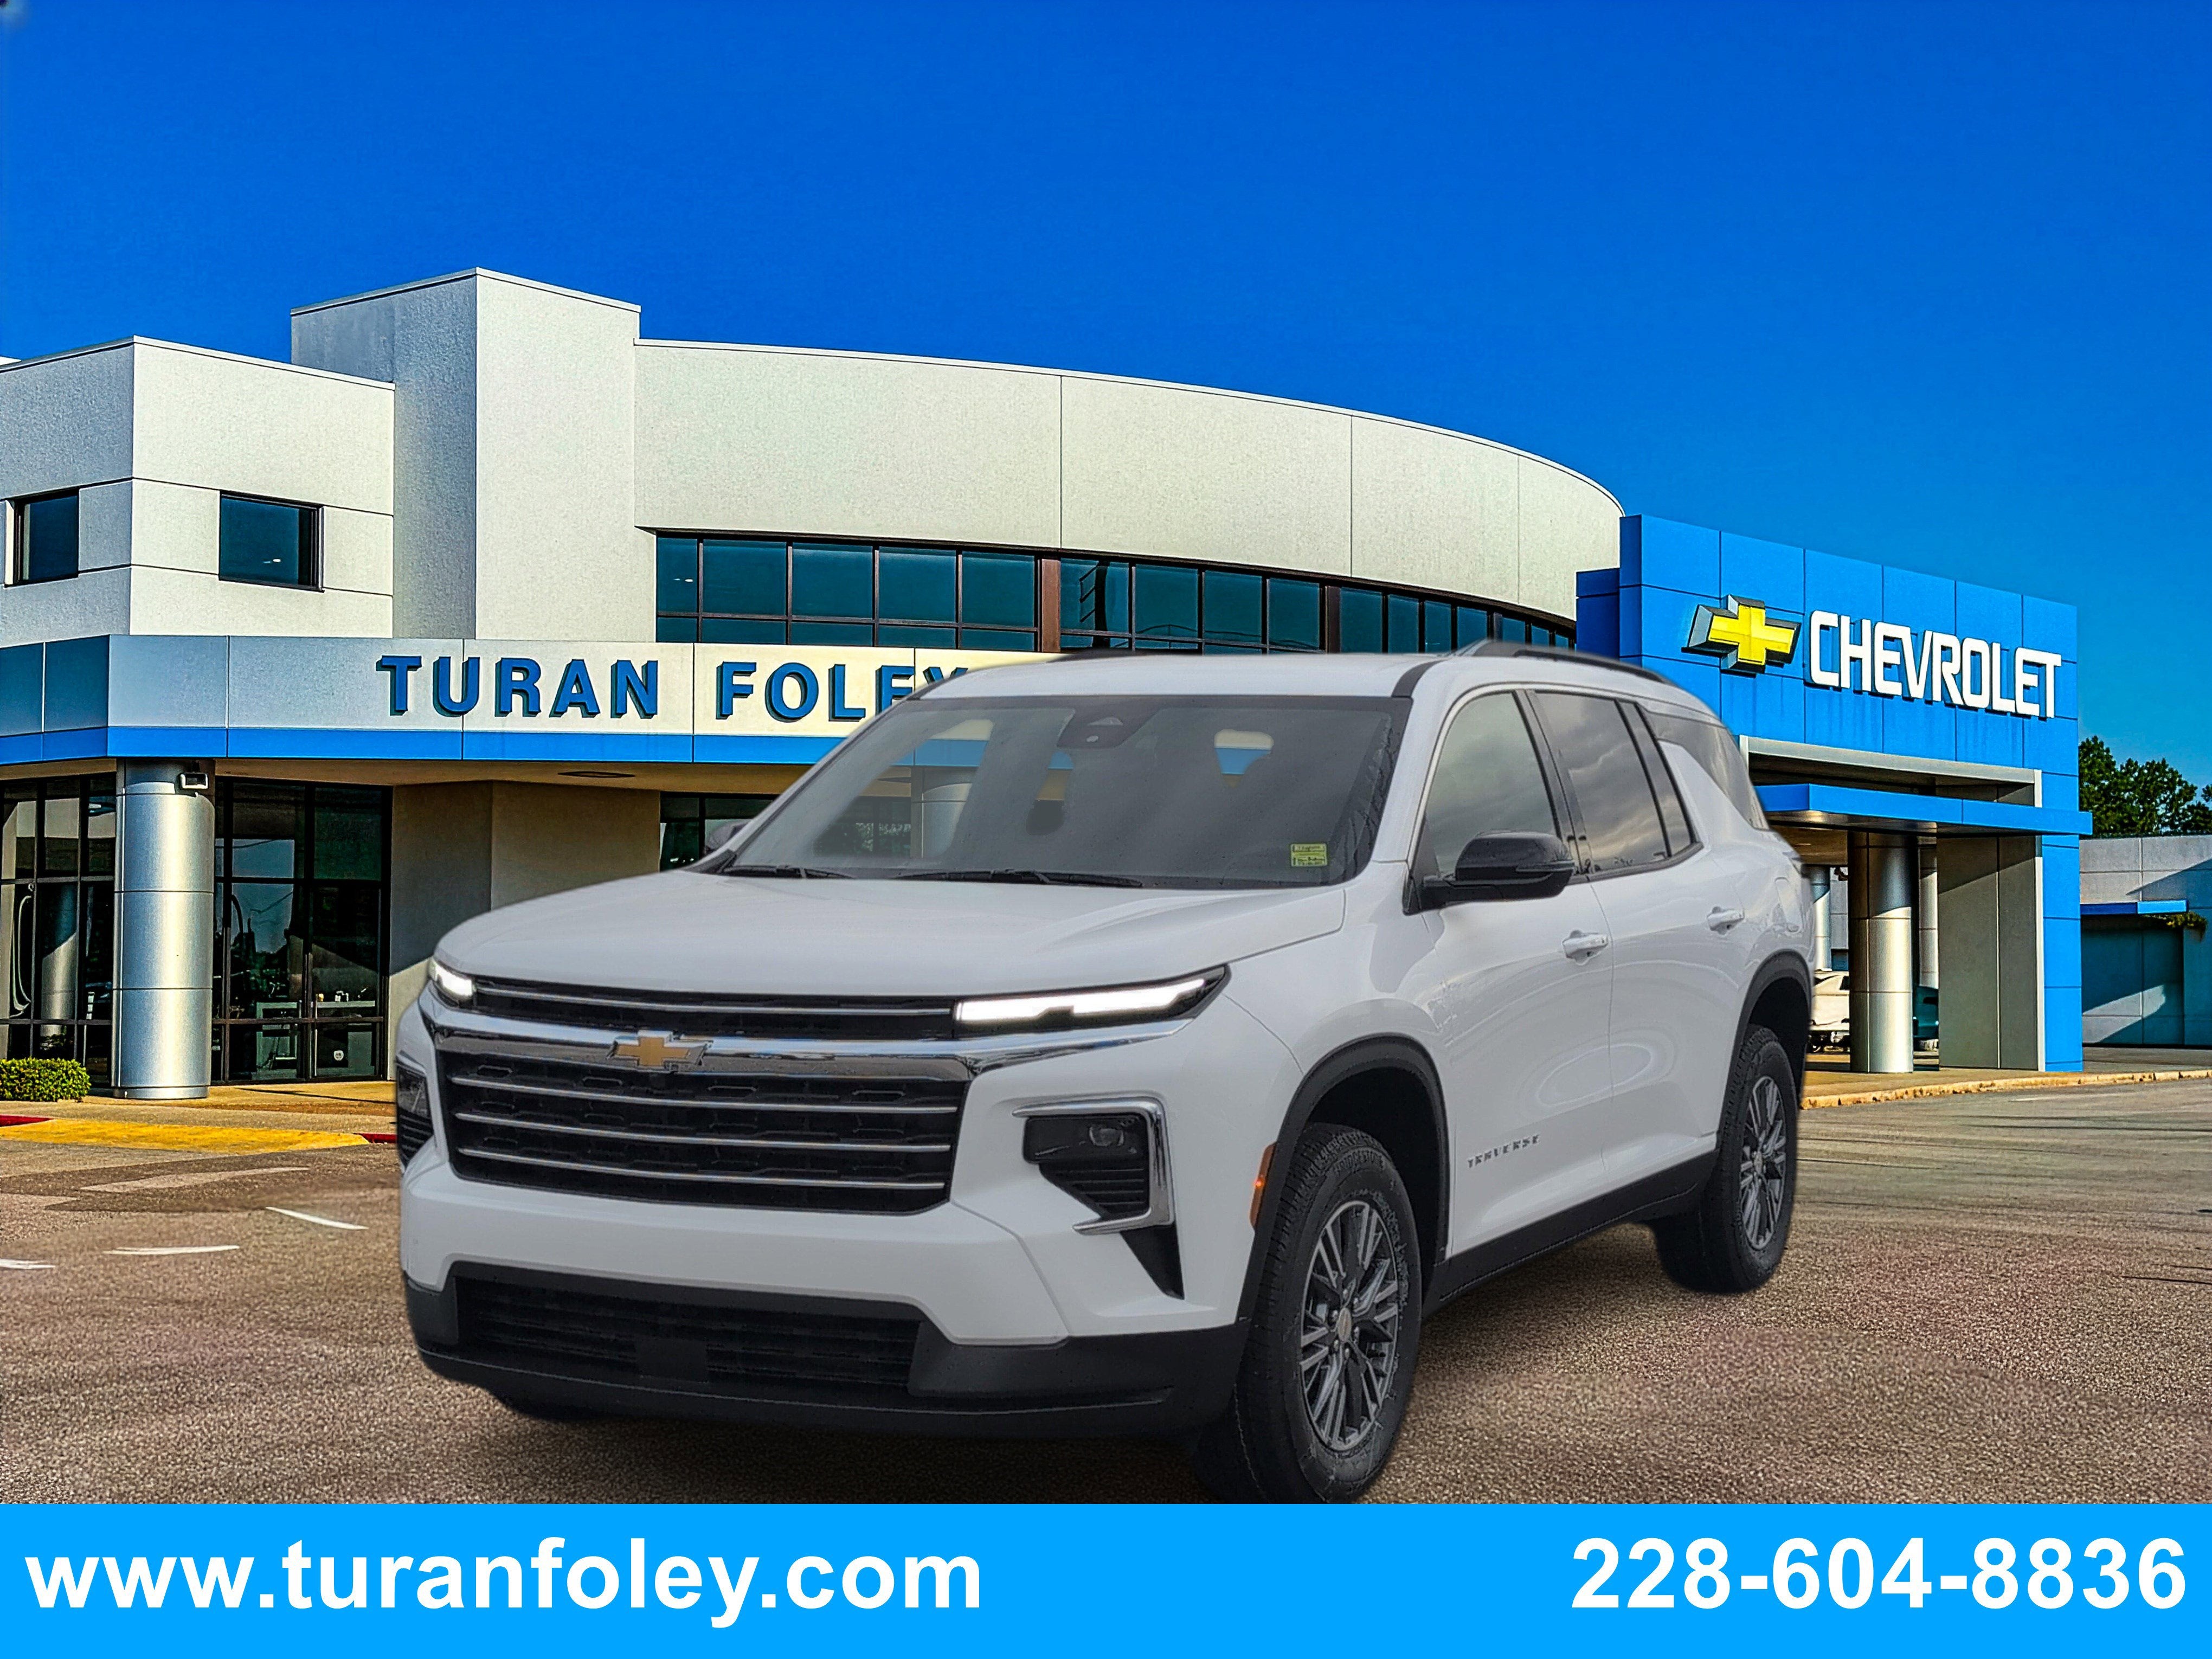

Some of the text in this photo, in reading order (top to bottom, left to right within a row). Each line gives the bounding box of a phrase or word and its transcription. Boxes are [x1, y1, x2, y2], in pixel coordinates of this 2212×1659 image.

[375, 655, 659, 719] TURAN
[1808, 610, 2062, 718] CHEVROLET
[1467, 1134, 1540, 1168] TRAVERSE
